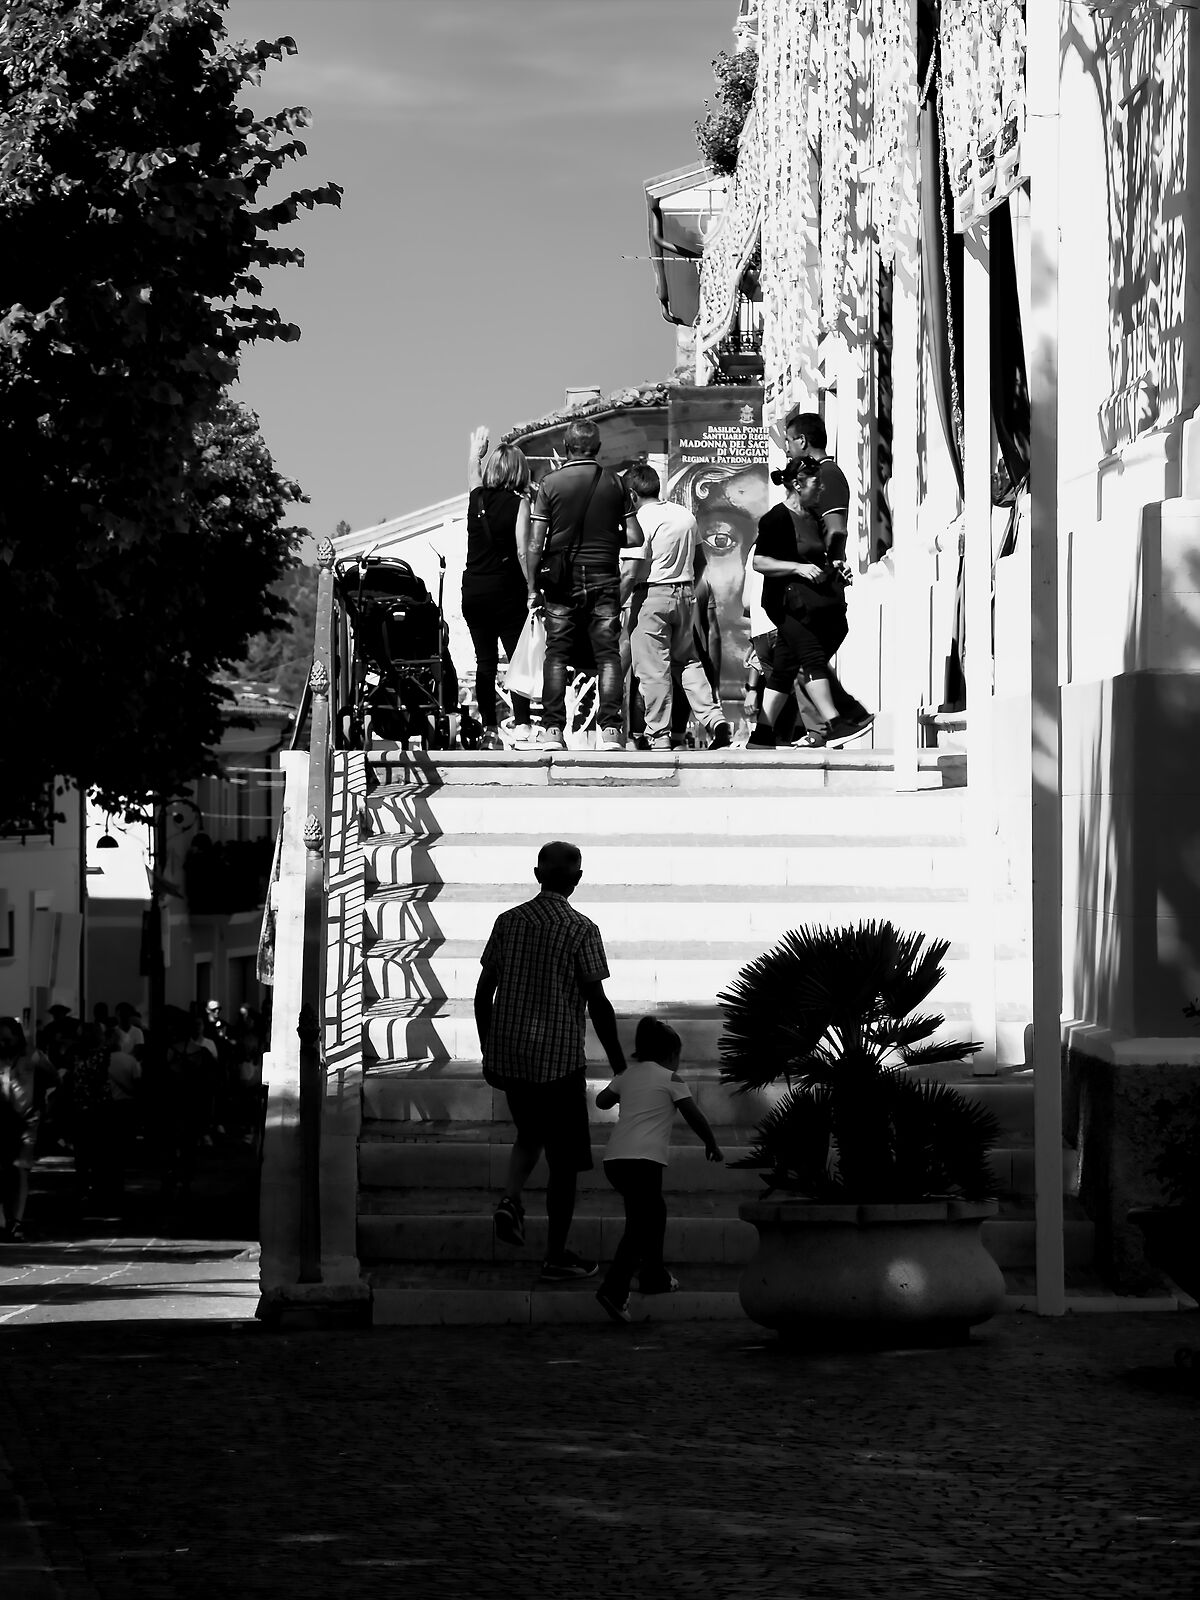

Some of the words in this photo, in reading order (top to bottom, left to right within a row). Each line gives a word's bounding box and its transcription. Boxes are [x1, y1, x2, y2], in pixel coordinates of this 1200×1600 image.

[679, 439, 728, 448] MADONNA
[730, 440, 746, 448] DEL
[717, 448, 727, 456] DI
[682, 455, 710, 463] REGINA
[717, 456, 752, 464] PATRONA
